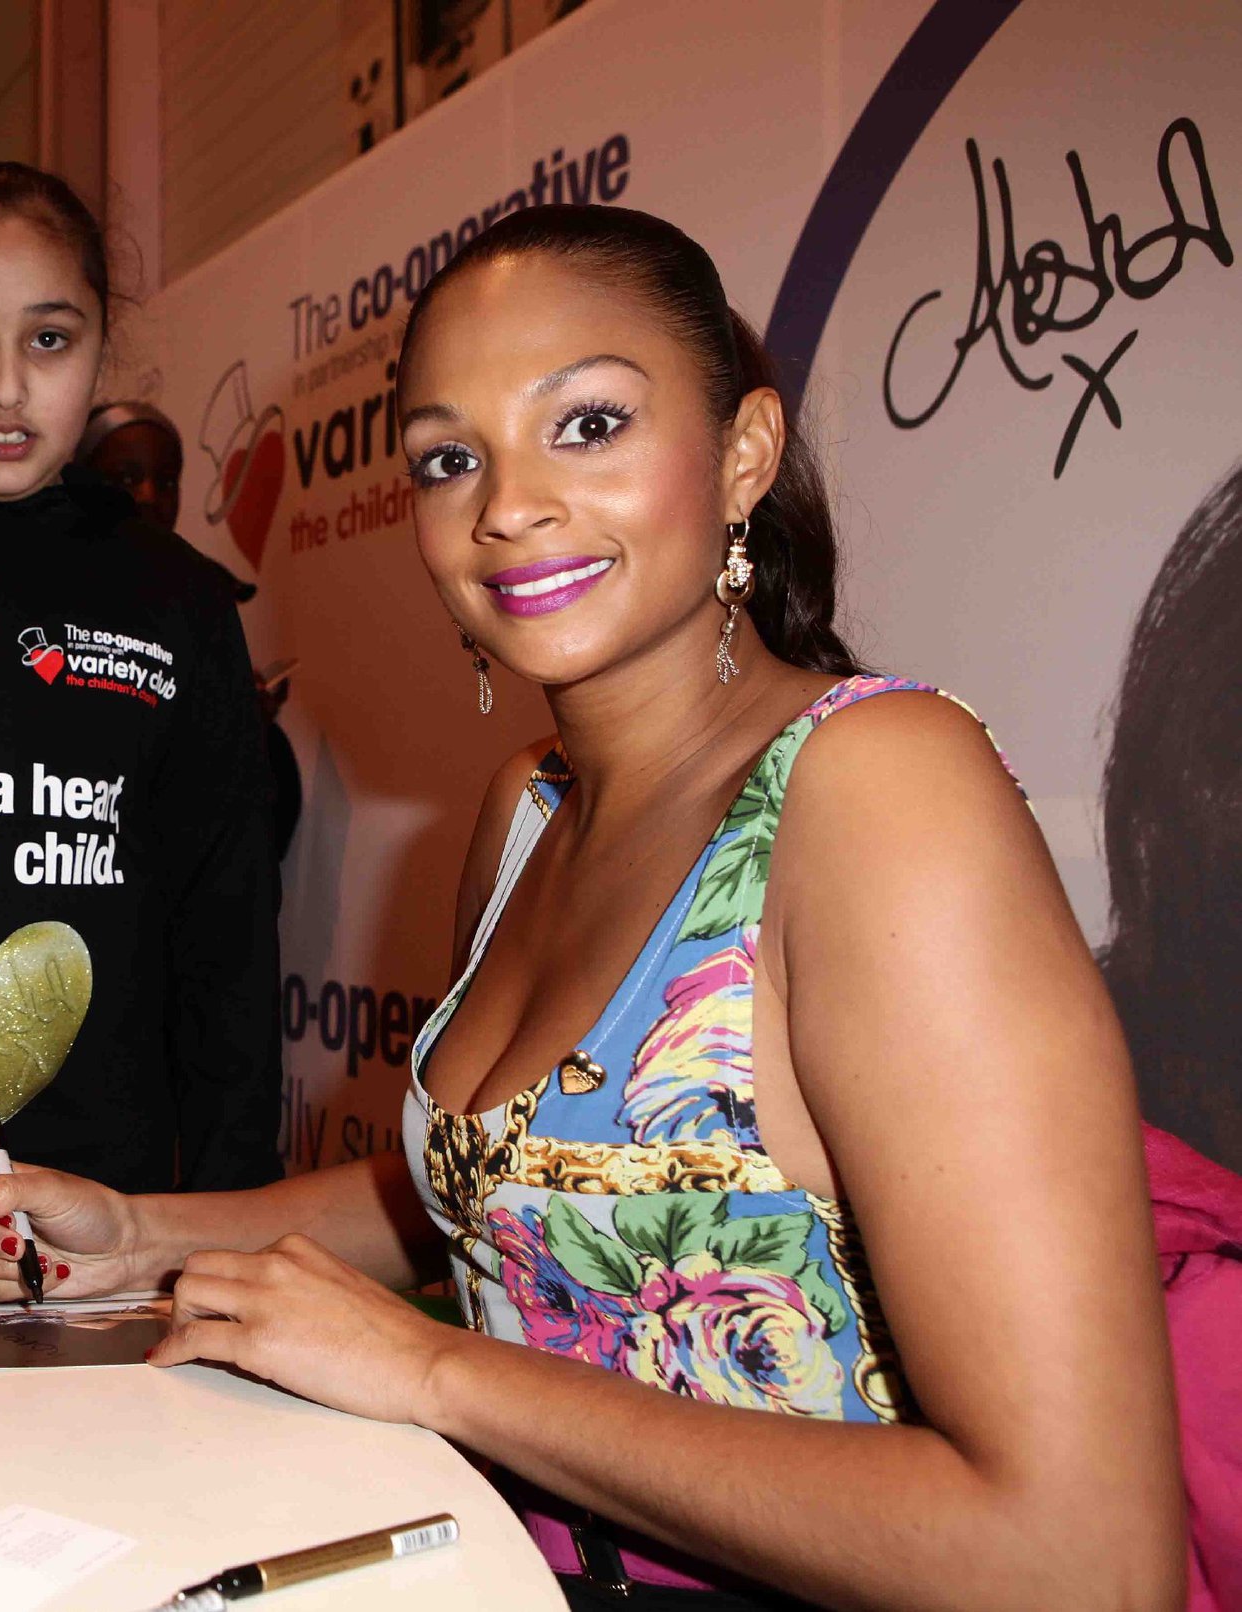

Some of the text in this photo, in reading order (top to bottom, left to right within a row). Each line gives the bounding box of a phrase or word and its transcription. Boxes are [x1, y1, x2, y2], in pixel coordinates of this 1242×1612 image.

[289, 293, 342, 360] The
[294, 360, 397, 489] vari
[290, 478, 414, 553] the childr
[64, 624, 173, 666] The co-operative
[67, 654, 176, 700] variety club
[66, 674, 85, 687] the
[87, 677, 137, 697] children's
[32, 762, 125, 834] heart,
[14, 831, 124, 885] child.
[283, 973, 437, 1078] o-oper
